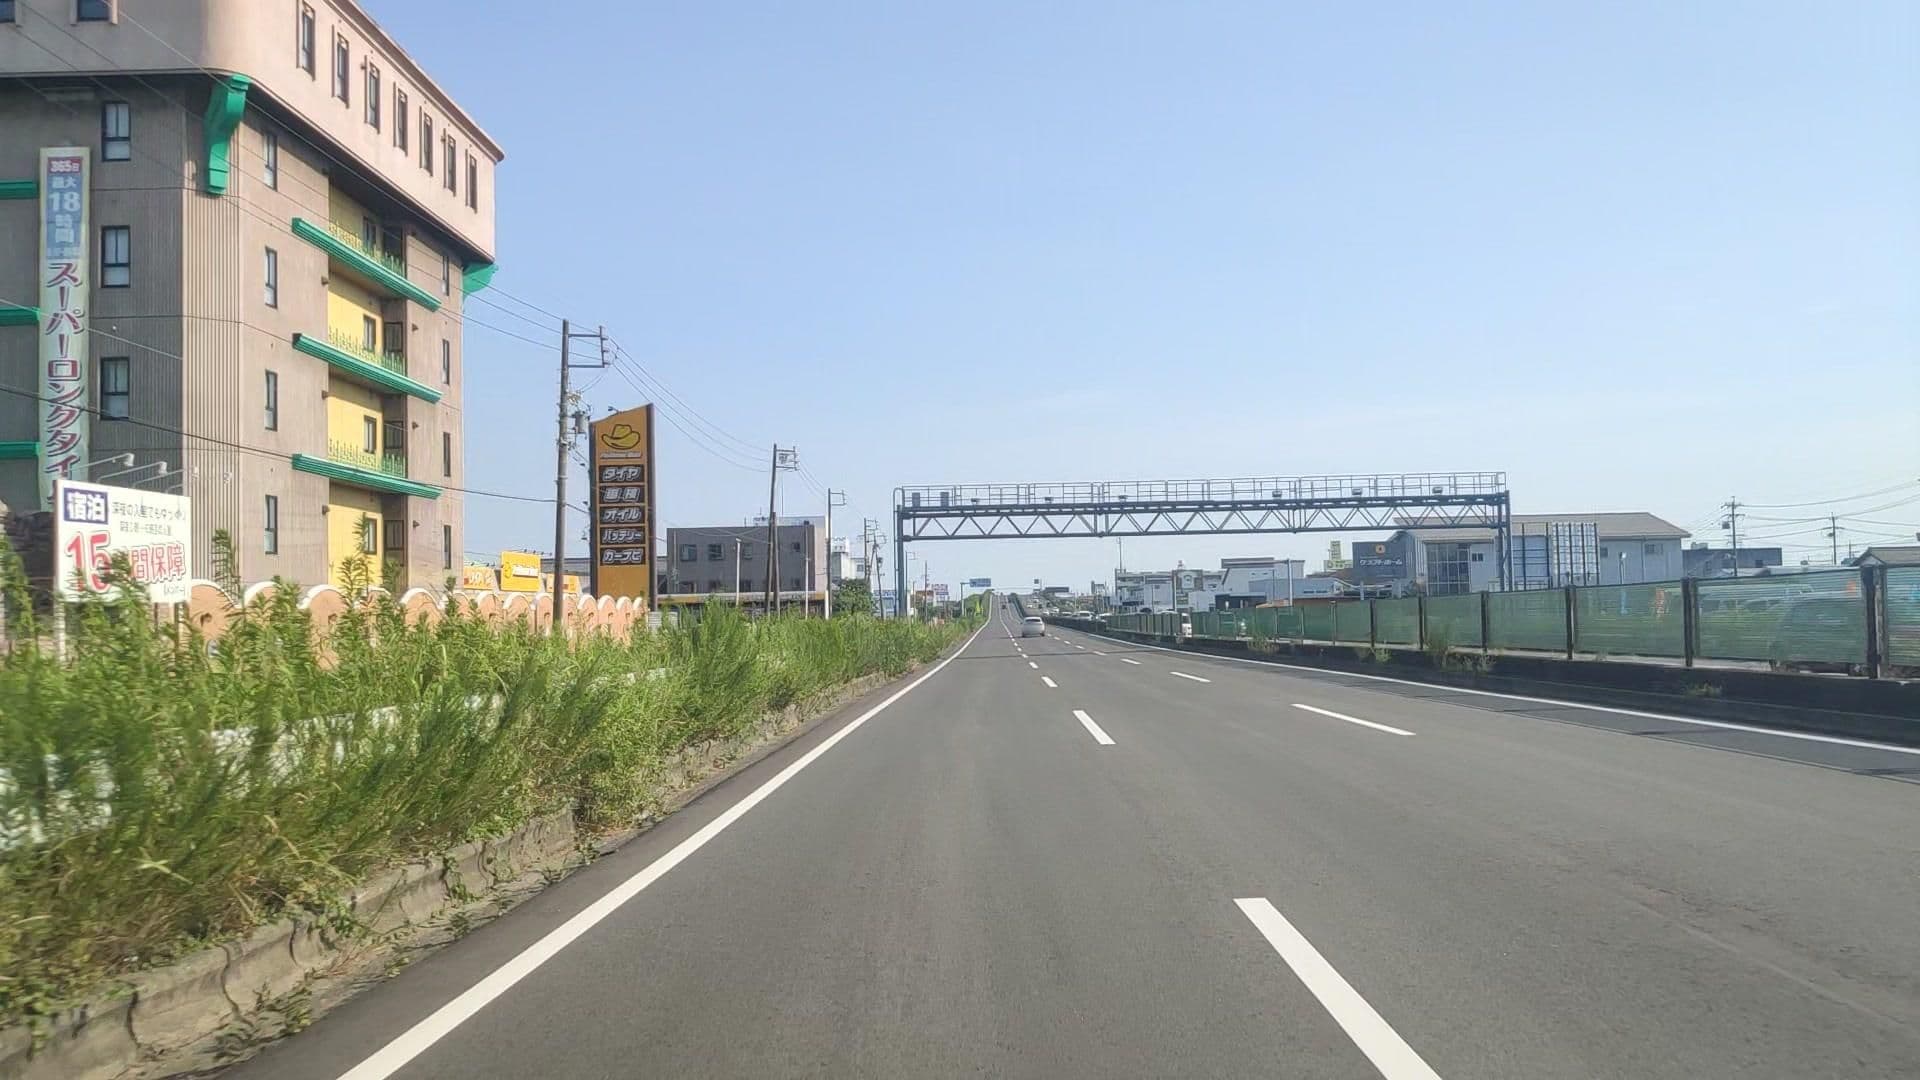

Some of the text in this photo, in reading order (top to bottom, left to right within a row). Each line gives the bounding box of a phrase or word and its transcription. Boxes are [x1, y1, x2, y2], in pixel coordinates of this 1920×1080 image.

[50, 160, 81, 173] 365日
[48, 191, 80, 212] 18
[602, 466, 642, 481] タイヤ
[67, 491, 105, 522] 宿泊
[602, 507, 642, 523] オイル
[64, 530, 186, 594] 15間保障
[601, 549, 643, 564] カーナビ
